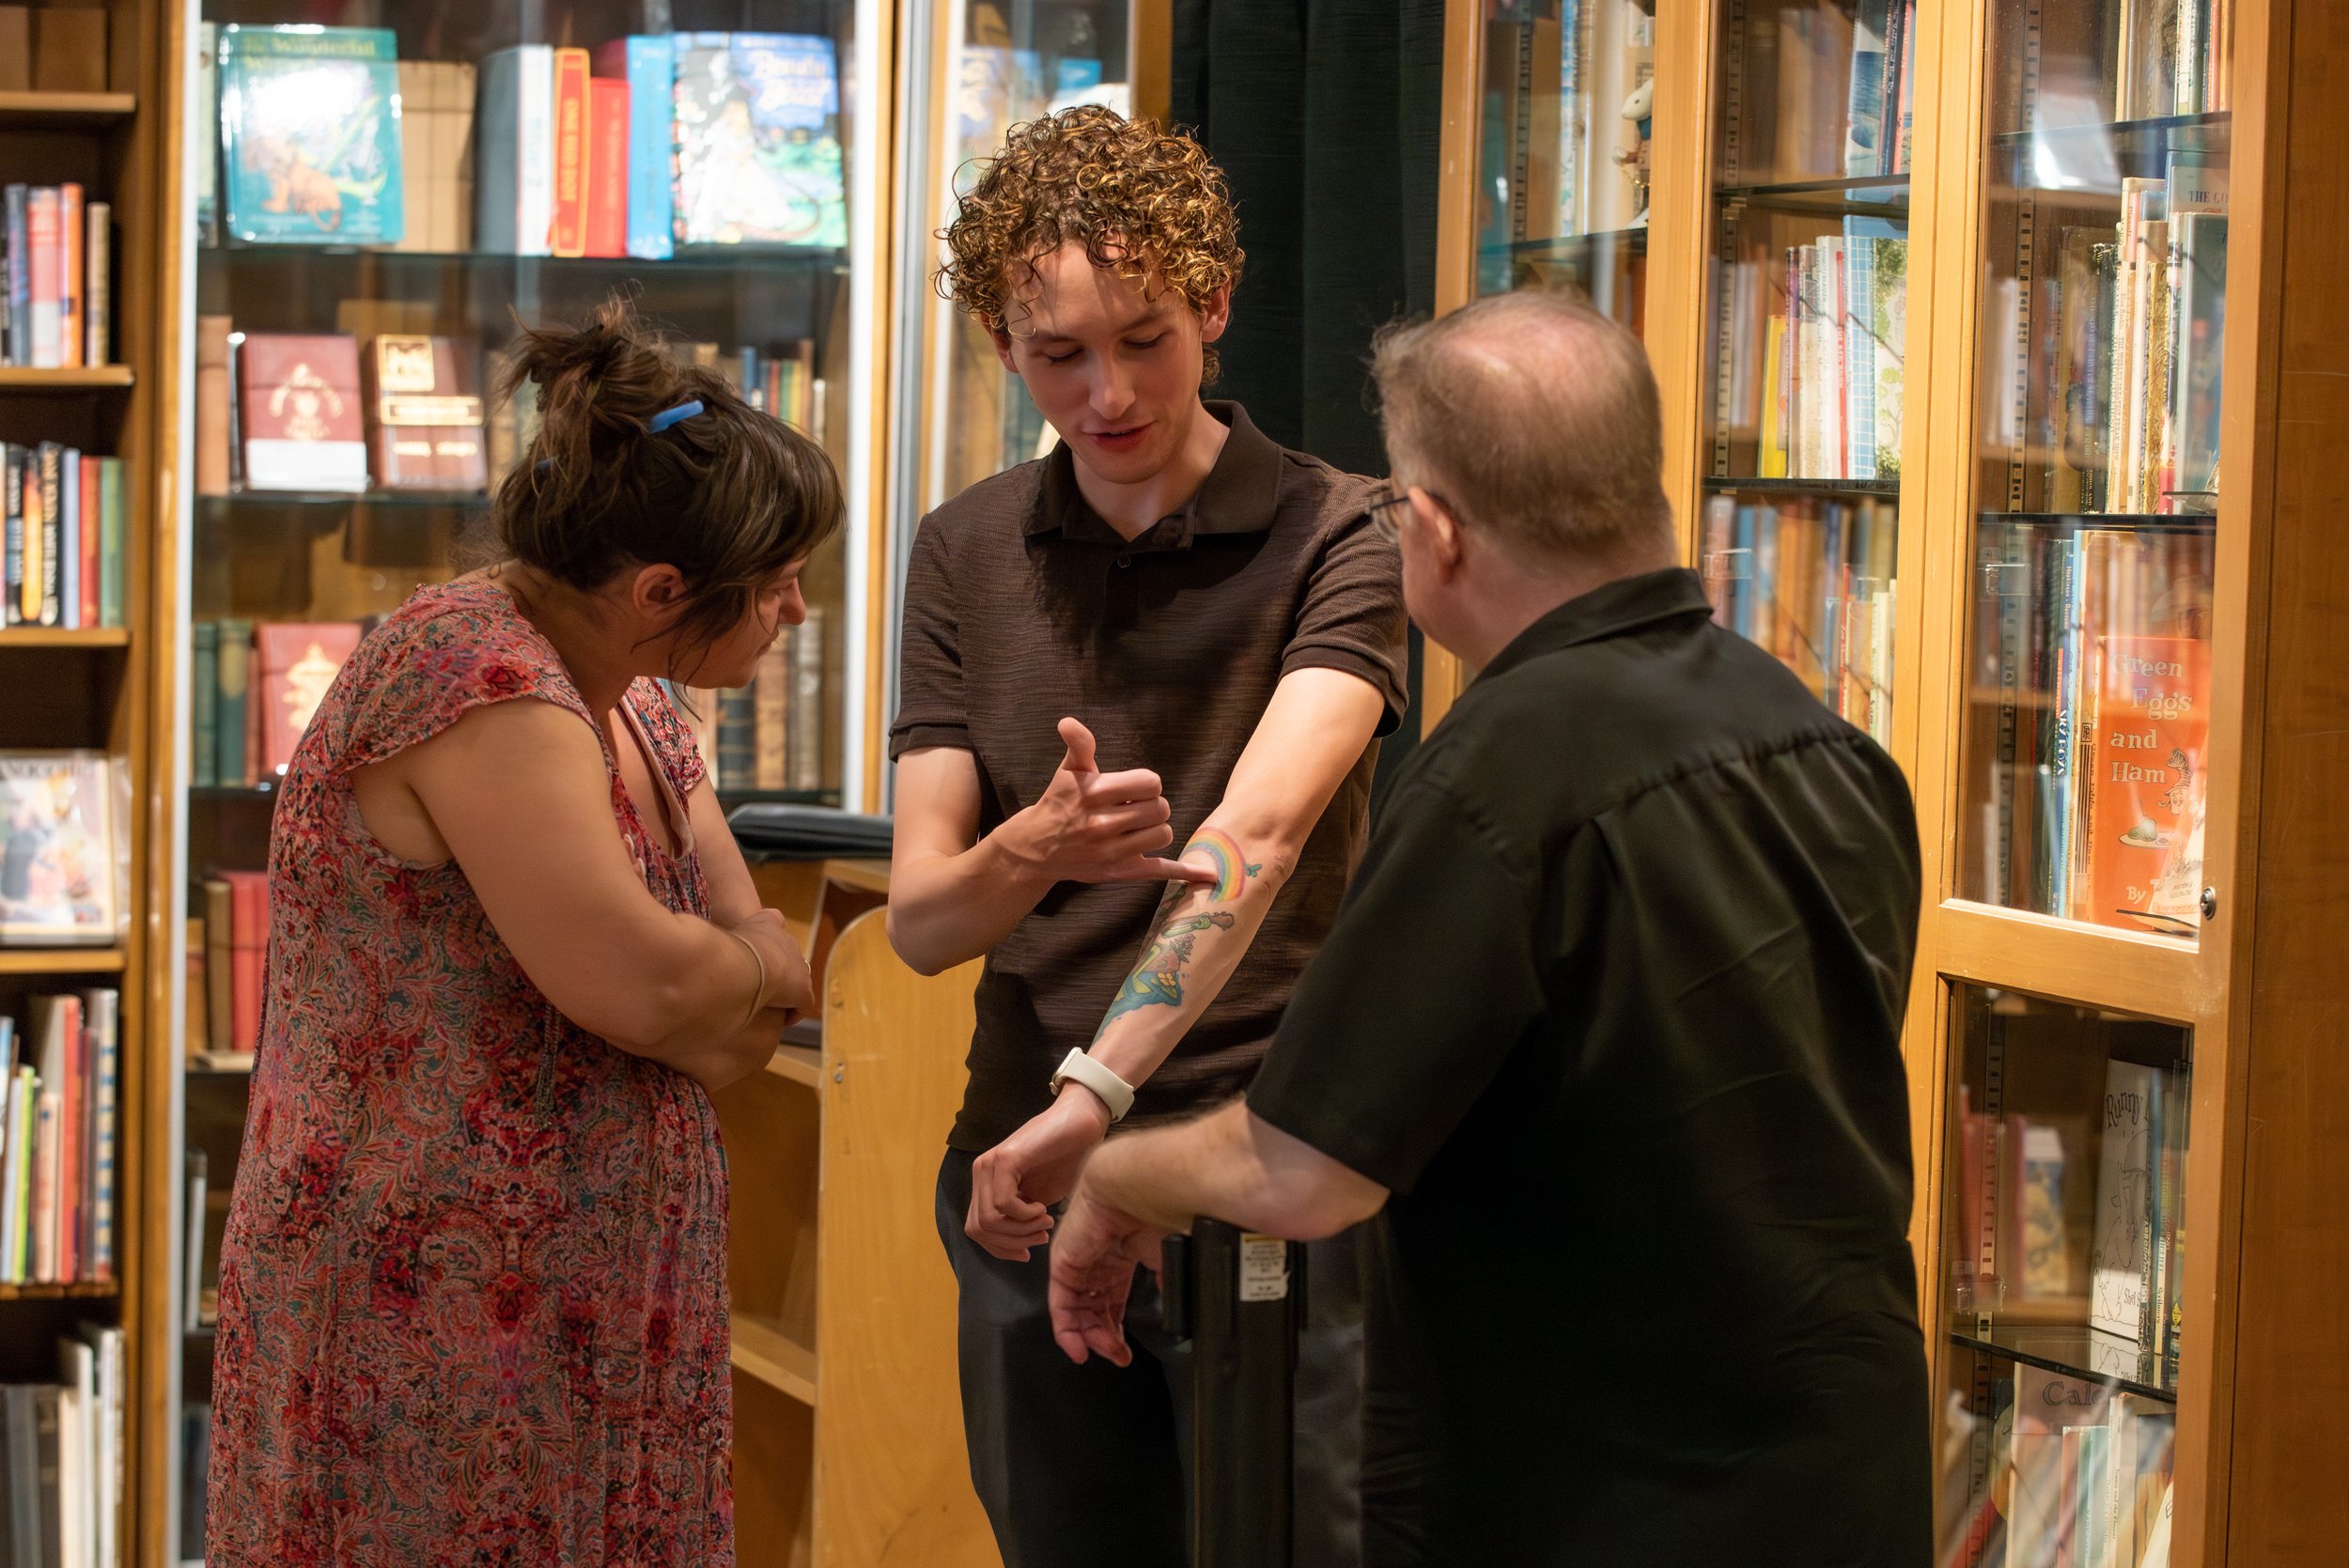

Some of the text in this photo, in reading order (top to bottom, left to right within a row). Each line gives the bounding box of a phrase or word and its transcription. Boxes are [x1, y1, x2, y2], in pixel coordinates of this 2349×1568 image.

[2187, 190, 2211, 204] THE
[2112, 653, 2184, 677] Green
[2131, 688, 2193, 721] Eggs
[2109, 729, 2158, 749] and
[2110, 762, 2167, 784] Ham
[2126, 886, 2147, 905] By
